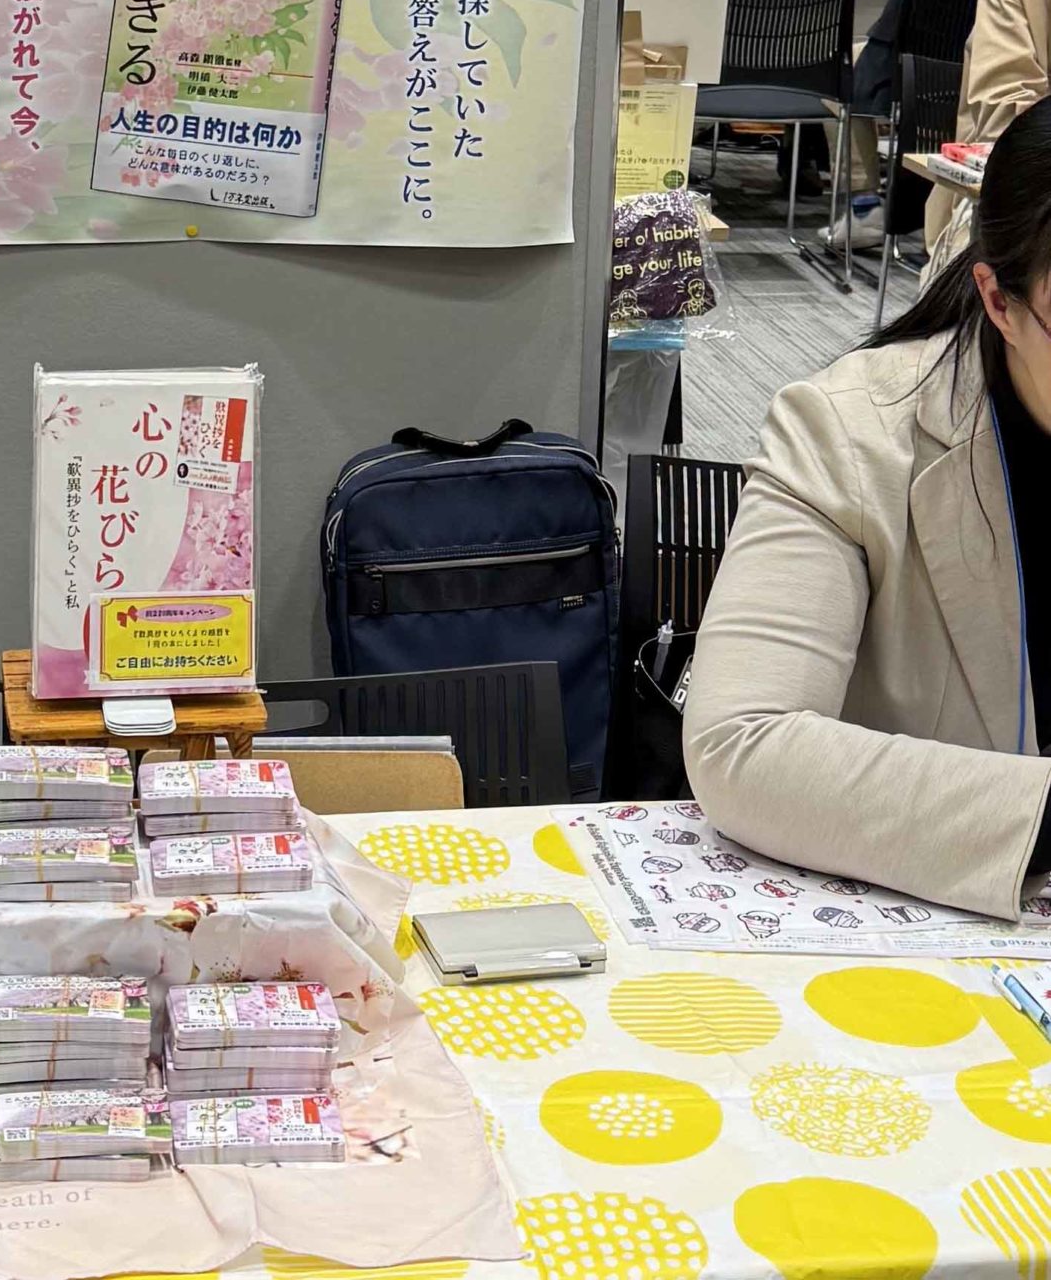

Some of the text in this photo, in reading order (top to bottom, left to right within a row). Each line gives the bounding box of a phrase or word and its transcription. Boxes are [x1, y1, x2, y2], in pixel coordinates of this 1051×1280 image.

[110, 107, 302, 149] 人生の目的は何か
[128, 158, 269, 184] どんな意味があるのだろう？
[653, 222, 700, 243] habits
[638, 256, 672, 277] your
[678, 250, 702, 269] life
[132, 402, 172, 480] 心の
[64, 454, 82, 610] 『歎異抄をひらく』と私
[91, 464, 139, 591] 花びら
[116, 655, 238, 668] ご自由にお持ちください
[65, 1187, 95, 1203] of
